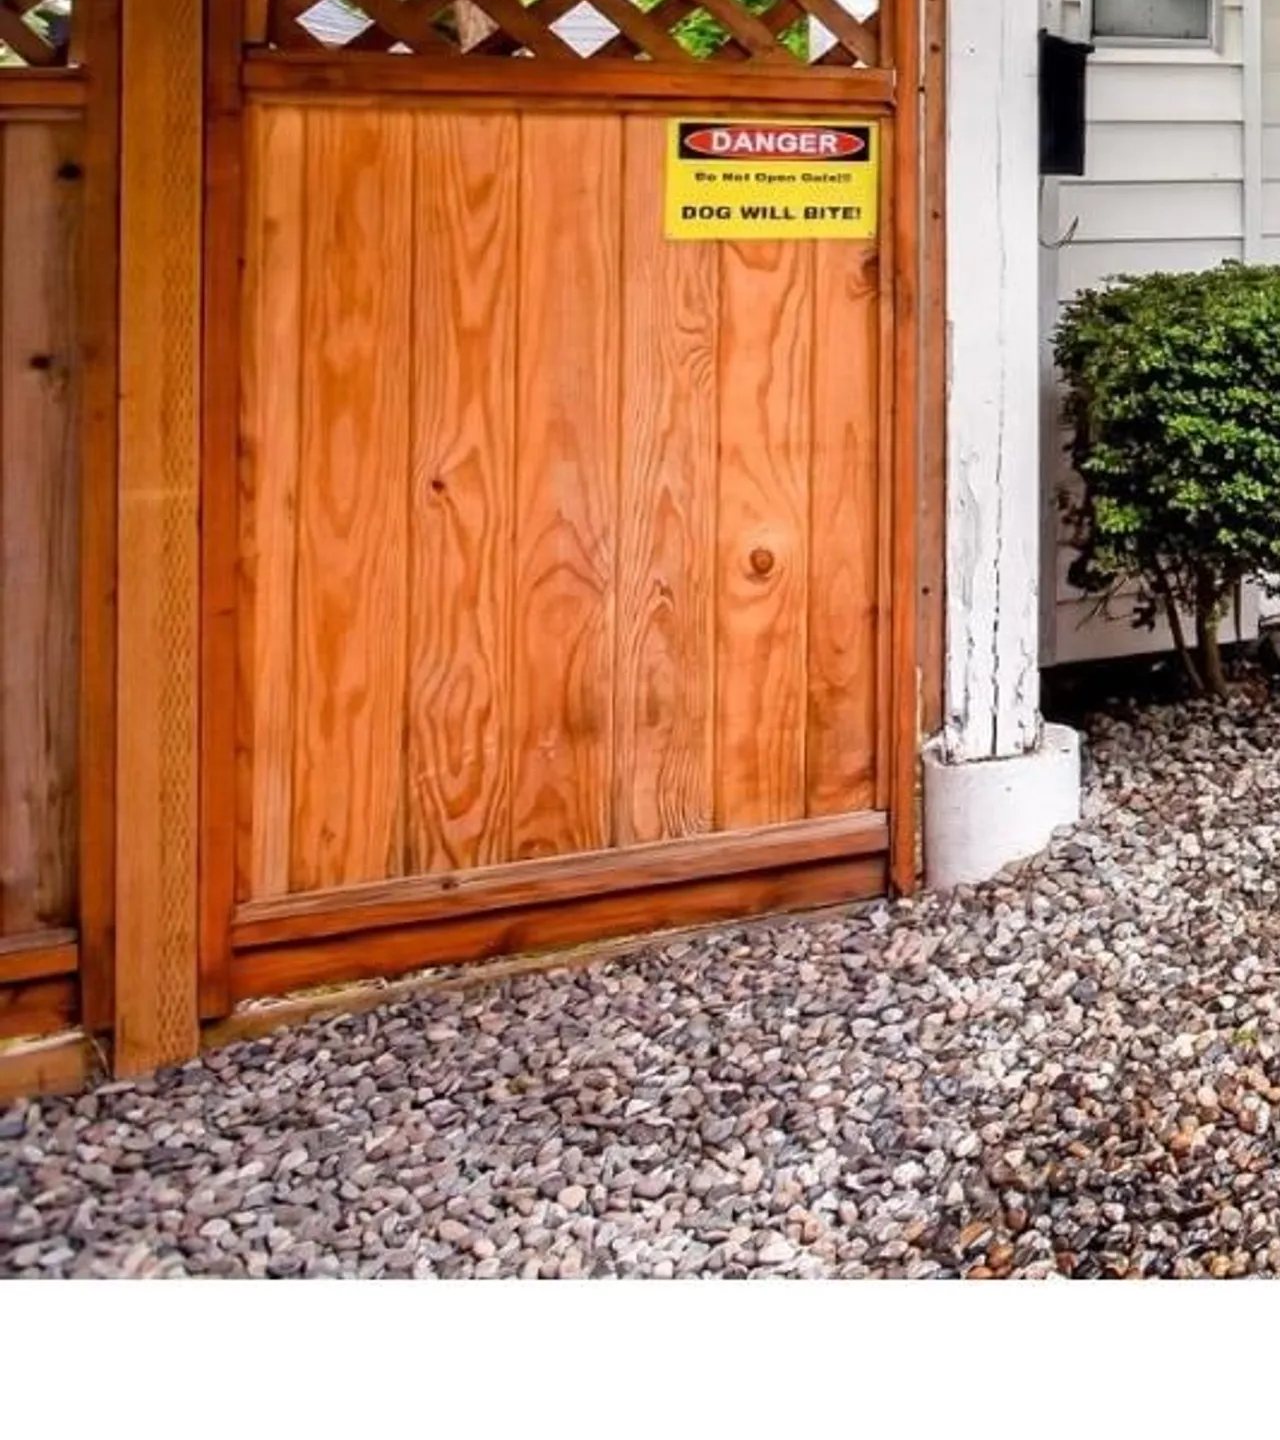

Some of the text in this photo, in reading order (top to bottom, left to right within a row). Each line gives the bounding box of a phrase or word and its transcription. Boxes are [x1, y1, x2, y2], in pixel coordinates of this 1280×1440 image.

[711, 131, 838, 153] DANGER
[695, 172, 717, 182] Do
[722, 172, 750, 182] Not
[755, 172, 796, 184] Open
[682, 206, 861, 221] DOG WILL BITE!
